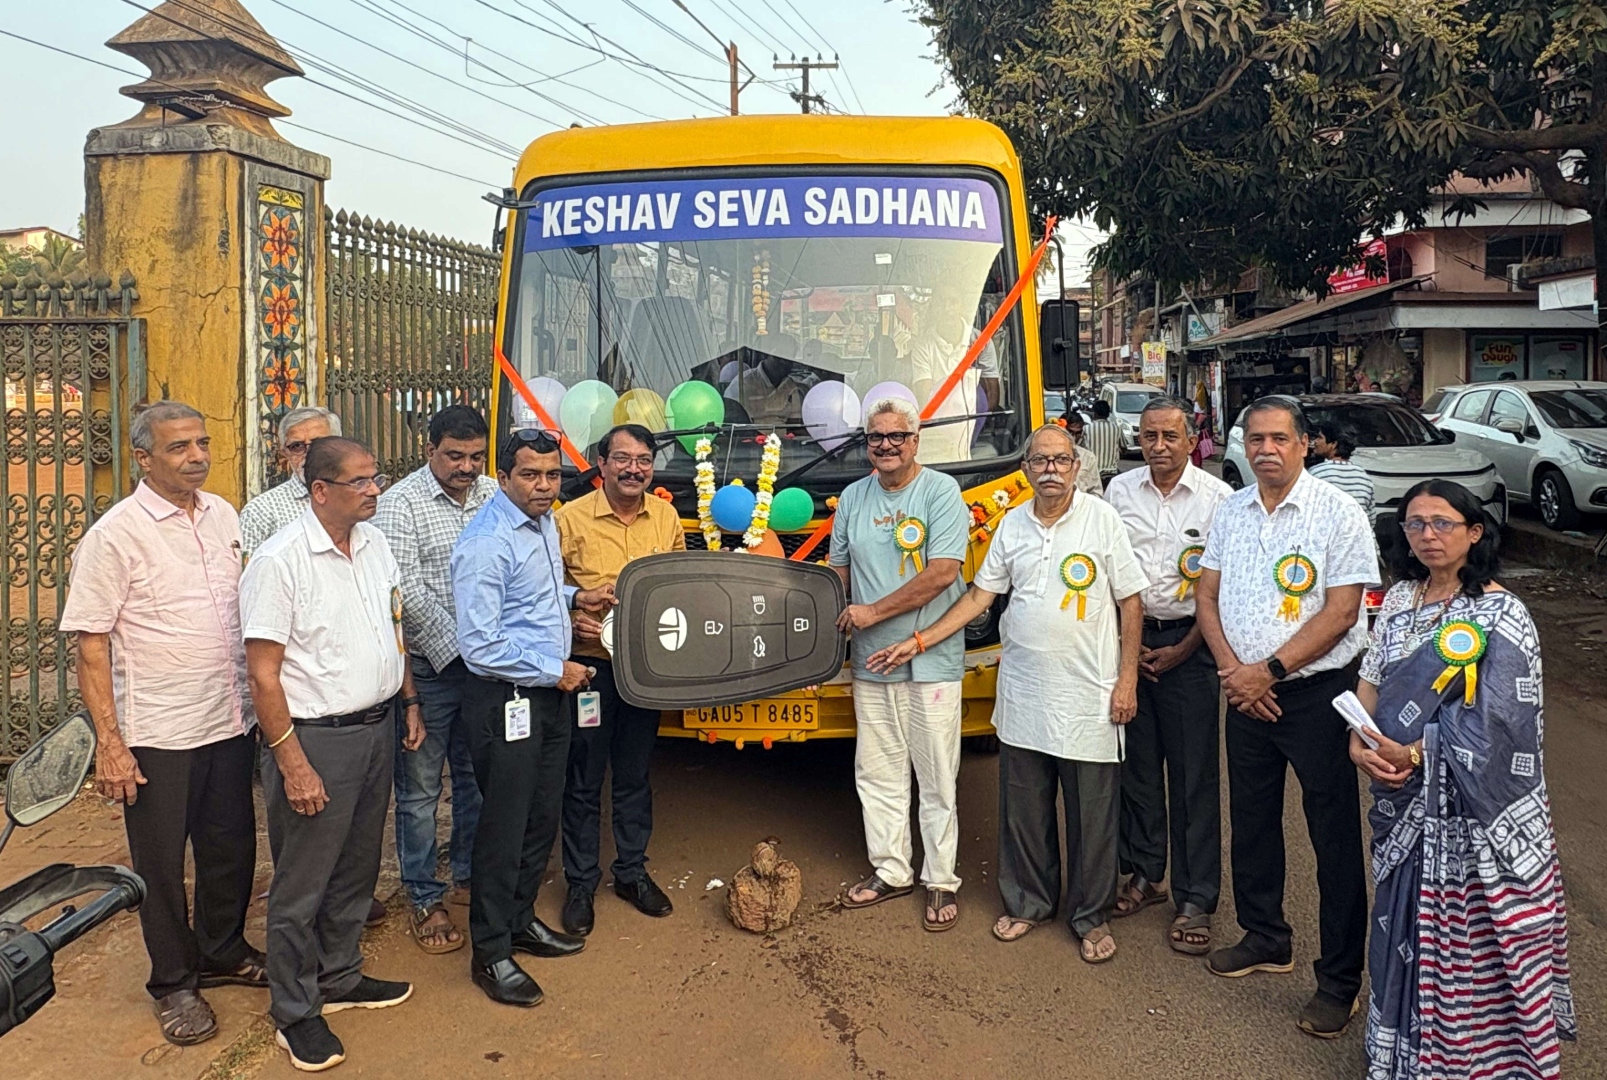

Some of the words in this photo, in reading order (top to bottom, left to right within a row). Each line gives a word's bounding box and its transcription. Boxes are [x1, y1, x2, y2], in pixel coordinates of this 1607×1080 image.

[541, 193, 681, 238] KESHAV
[693, 188, 791, 229] SEVA
[804, 186, 987, 231] SADHANA
[1488, 342, 1512, 354] Fun
[1147, 350, 1162, 360] BIG
[1481, 352, 1518, 364] Dough
[698, 704, 744, 723] GA05
[751, 704, 760, 723] T
[768, 703, 814, 724] 8485
